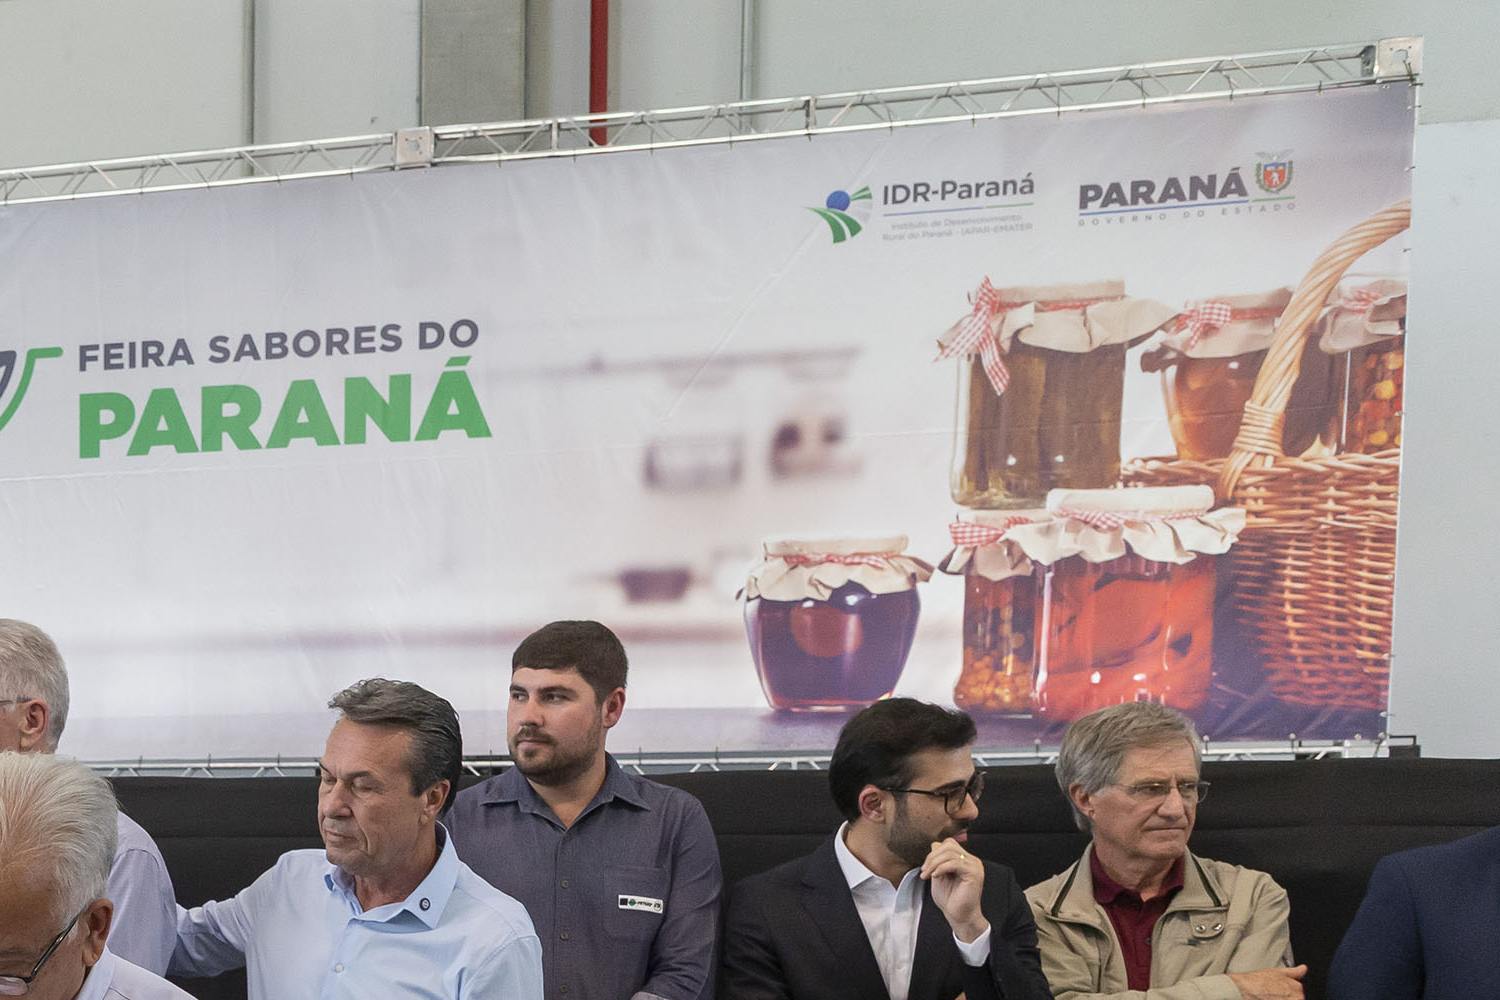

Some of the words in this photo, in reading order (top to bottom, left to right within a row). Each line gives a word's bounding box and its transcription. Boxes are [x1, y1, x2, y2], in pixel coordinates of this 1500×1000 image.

[883, 172, 1035, 205] IDR-Paraná
[1079, 167, 1249, 210] PARANÁ
[1078, 213, 1167, 226] GOVERNO
[1183, 210, 1205, 218] DO
[1221, 203, 1295, 216] ESTADO
[78, 338, 195, 372] FEIRA
[207, 325, 402, 364] SABORES
[417, 318, 480, 351] DO
[78, 356, 492, 459] PARANÁ
